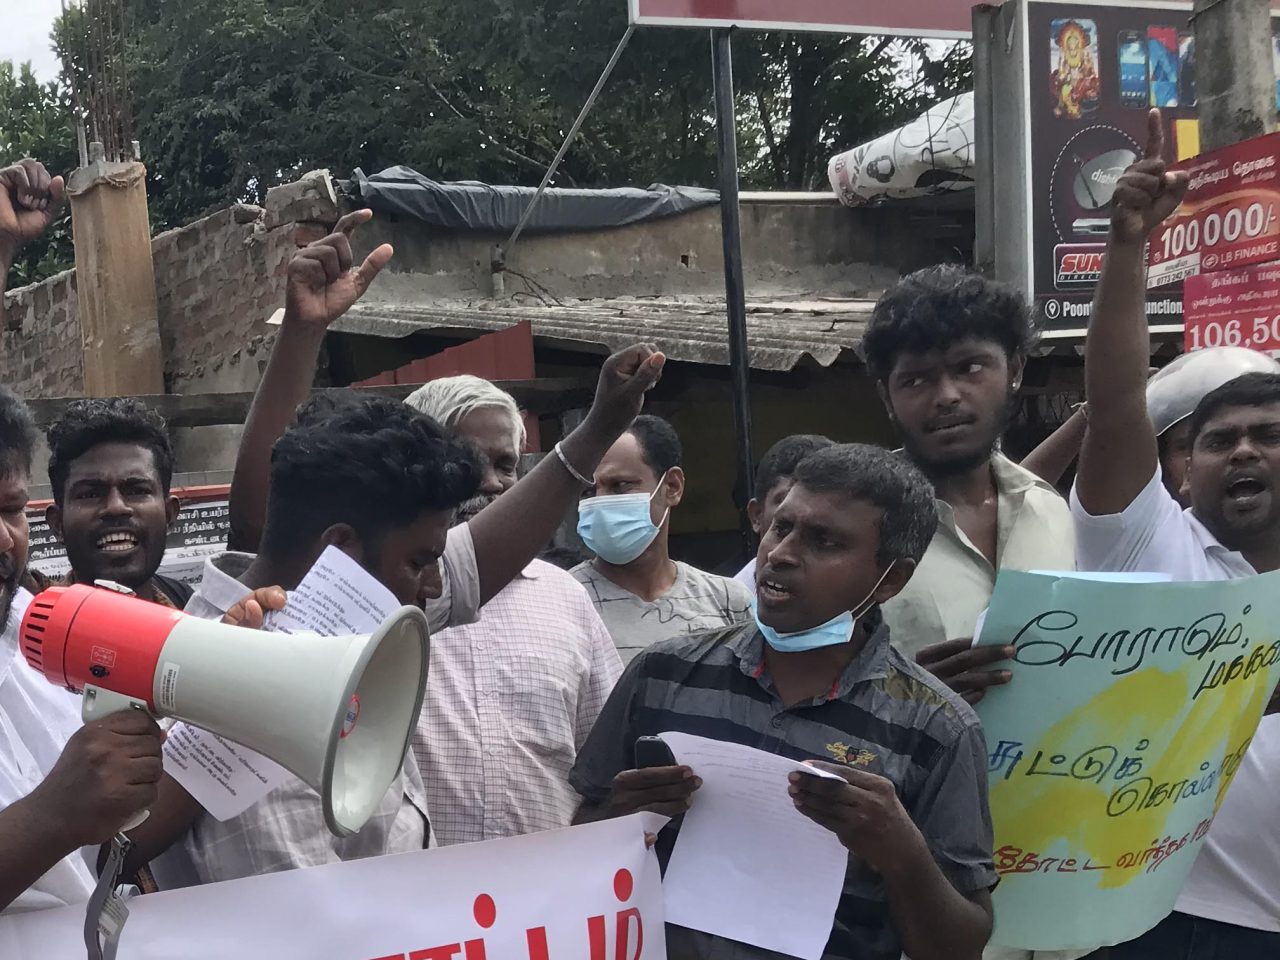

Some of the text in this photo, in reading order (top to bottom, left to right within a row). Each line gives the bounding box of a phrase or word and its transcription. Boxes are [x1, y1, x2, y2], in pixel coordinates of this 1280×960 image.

[1060, 252, 1107, 273] SUN
[1220, 241, 1278, 264] LB FINANCE
[1145, 299, 1185, 315] unction.
